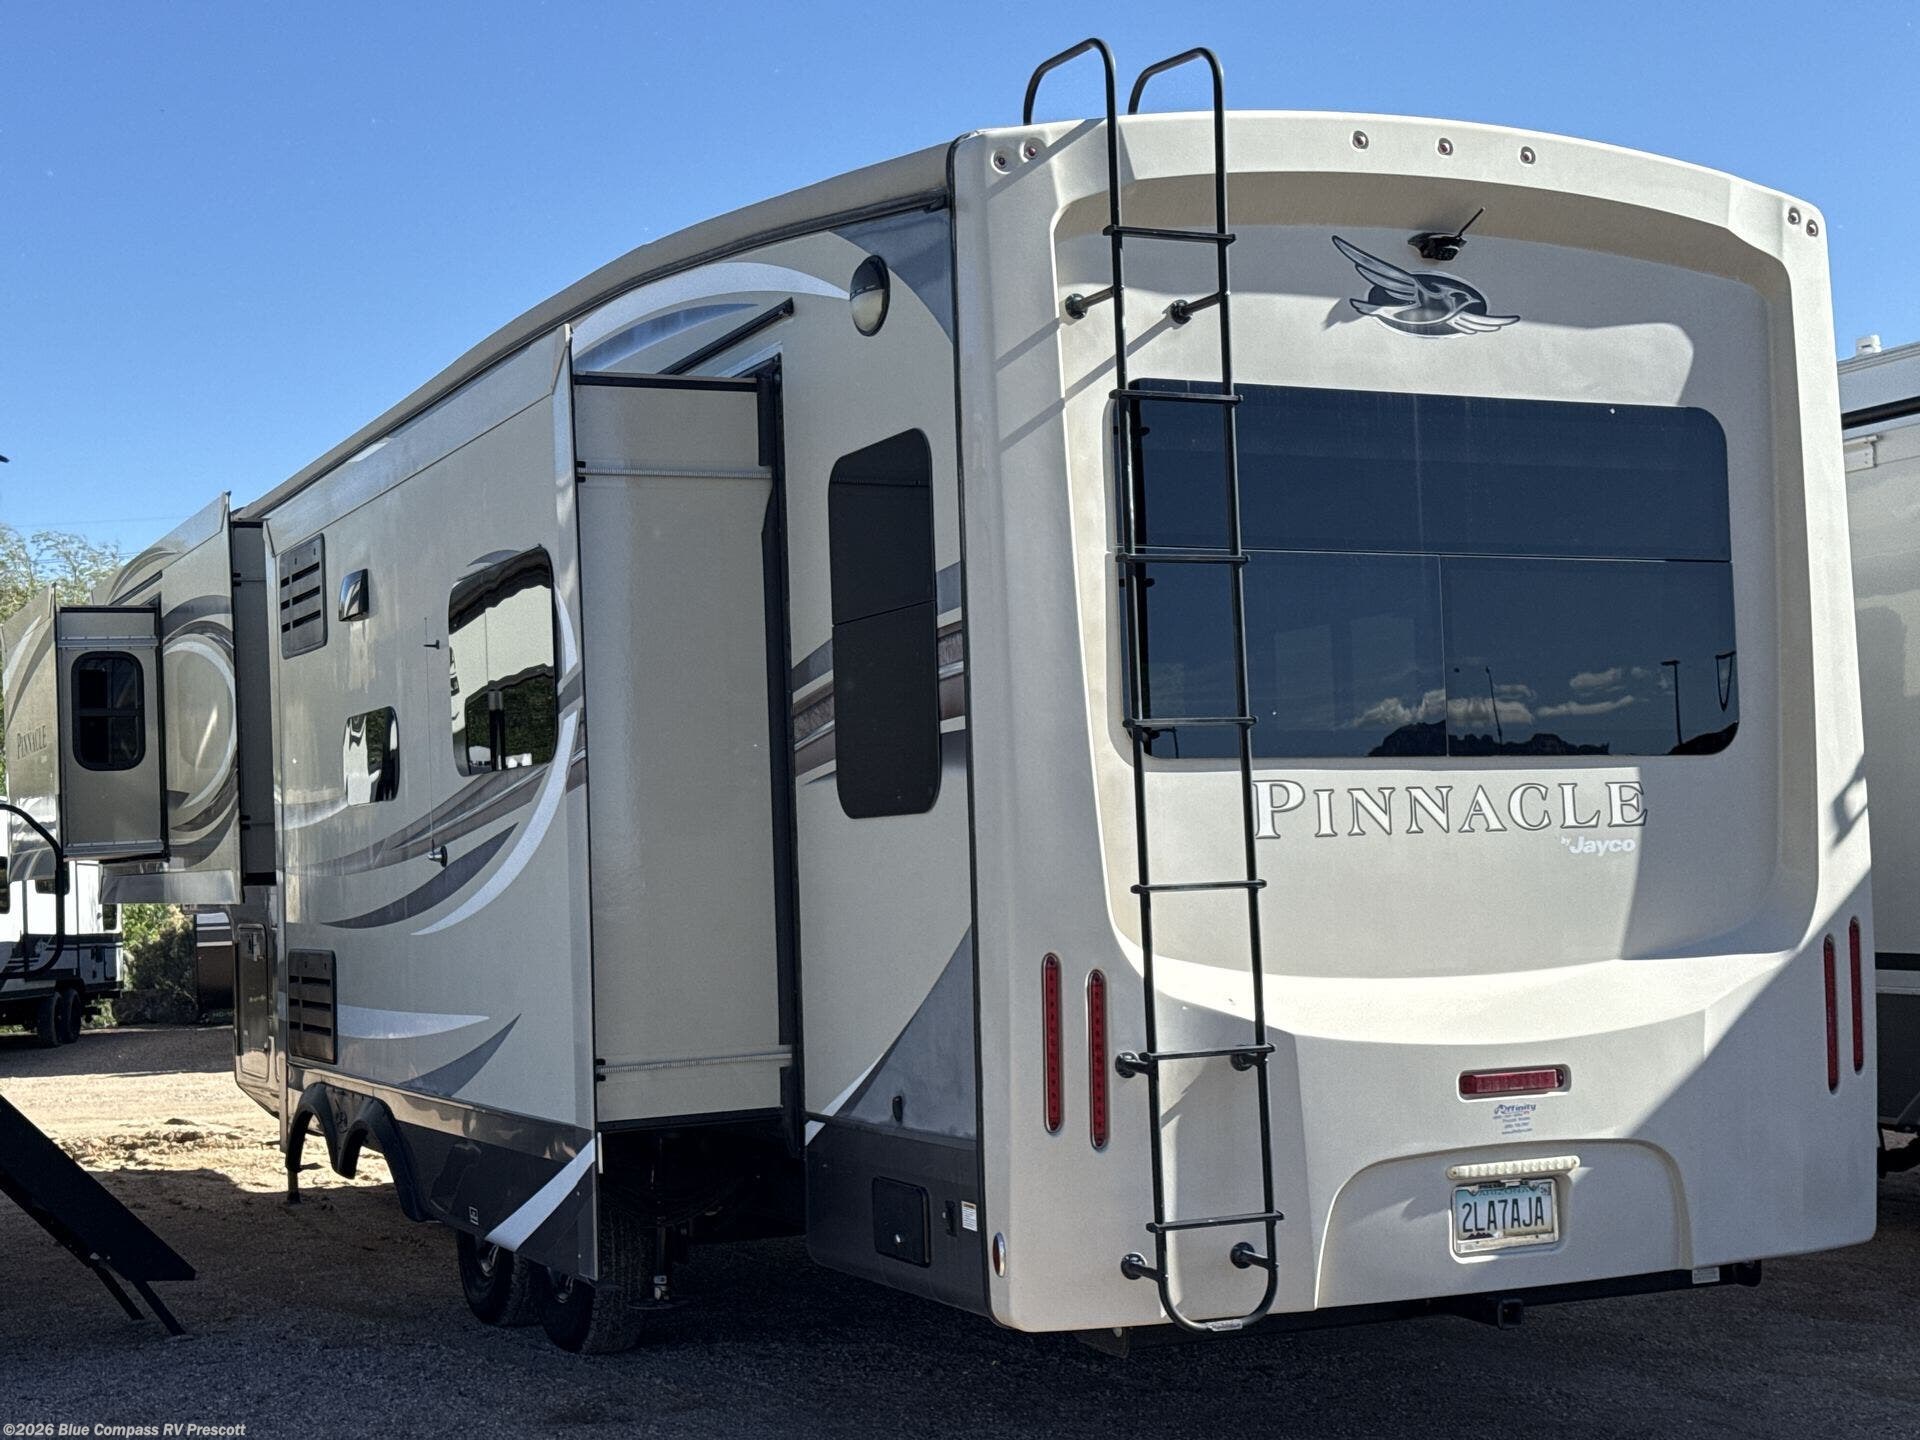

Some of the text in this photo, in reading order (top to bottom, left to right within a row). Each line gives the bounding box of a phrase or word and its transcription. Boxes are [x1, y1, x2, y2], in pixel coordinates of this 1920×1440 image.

[1252, 779, 1648, 839] PINNACLE
[1569, 836, 1635, 856] Jayco
[1494, 1103, 1537, 1114] Affinity
[1462, 1196, 1544, 1233] 2LA7AJA
